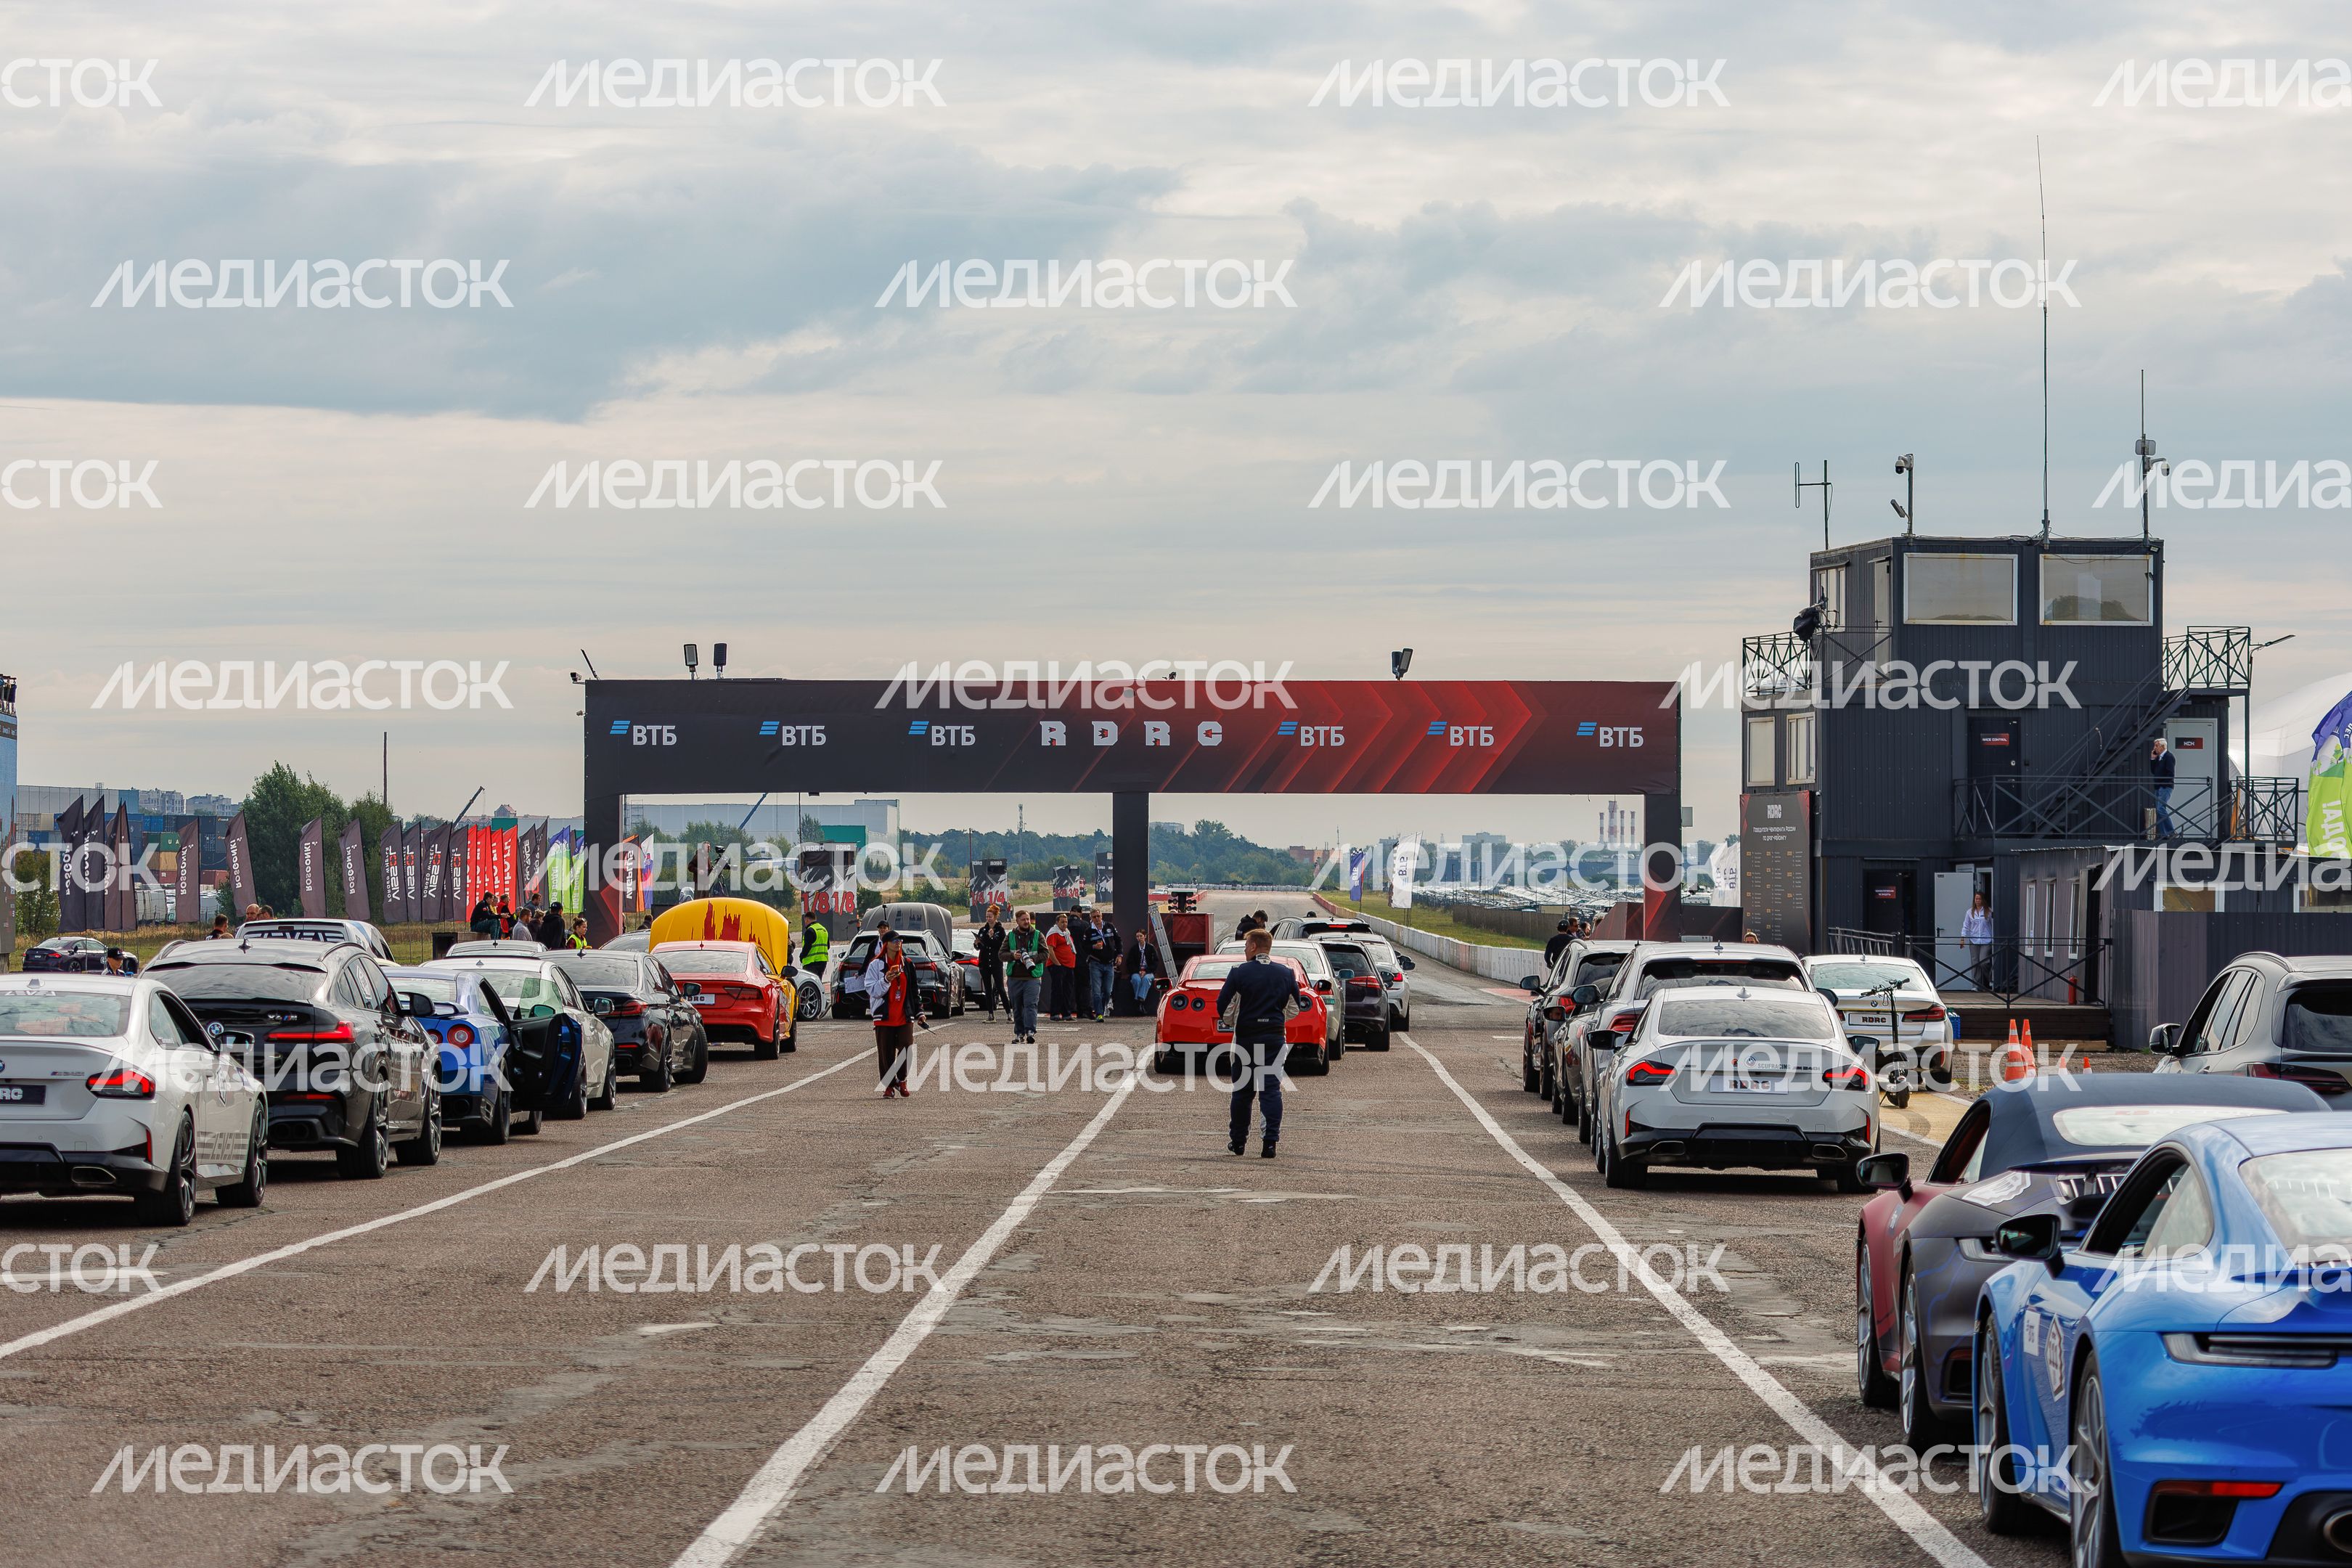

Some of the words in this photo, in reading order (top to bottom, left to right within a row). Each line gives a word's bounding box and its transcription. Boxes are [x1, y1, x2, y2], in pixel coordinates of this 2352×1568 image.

[633, 725, 677, 746] ВТБ
[783, 725, 826, 746] ВТБ
[931, 725, 976, 746] ВТБ
[1299, 726, 1345, 746] ВТБ
[1450, 726, 1495, 746] ВТБ
[1599, 727, 1644, 747] ВТБ
[1767, 804, 1782, 819] RDRC
[801, 891, 830, 914] 1/8
[831, 891, 855, 915] 1/8
[971, 891, 985, 907] 1/4
[987, 890, 1005, 905] 1/4
[1069, 888, 1079, 898] 3/8
[1728, 1079, 1771, 1090] RDRC
